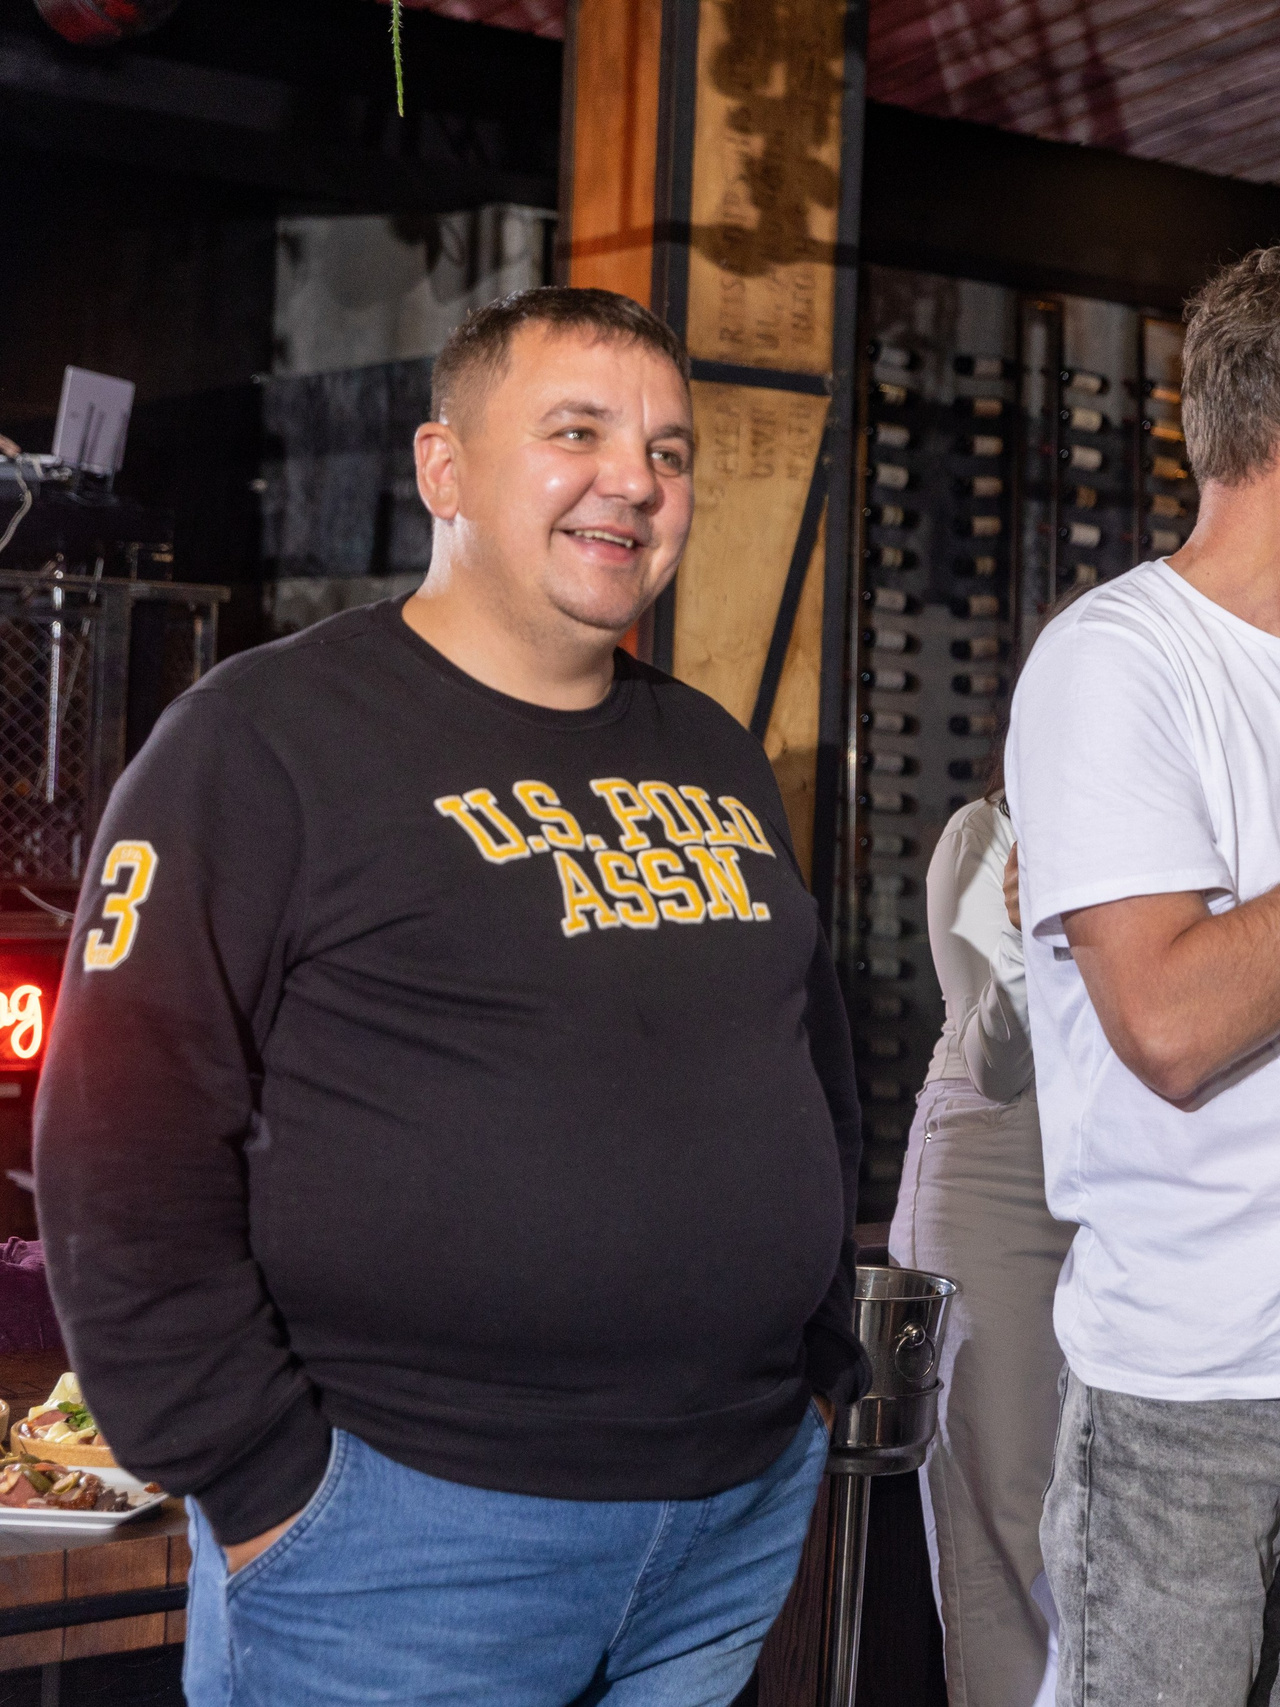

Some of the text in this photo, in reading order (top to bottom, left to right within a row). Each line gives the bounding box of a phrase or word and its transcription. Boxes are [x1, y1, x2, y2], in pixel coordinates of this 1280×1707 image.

[434, 777, 776, 864] U.S. POLO
[84, 840, 160, 971] 3
[553, 845, 771, 938] ASSN.
